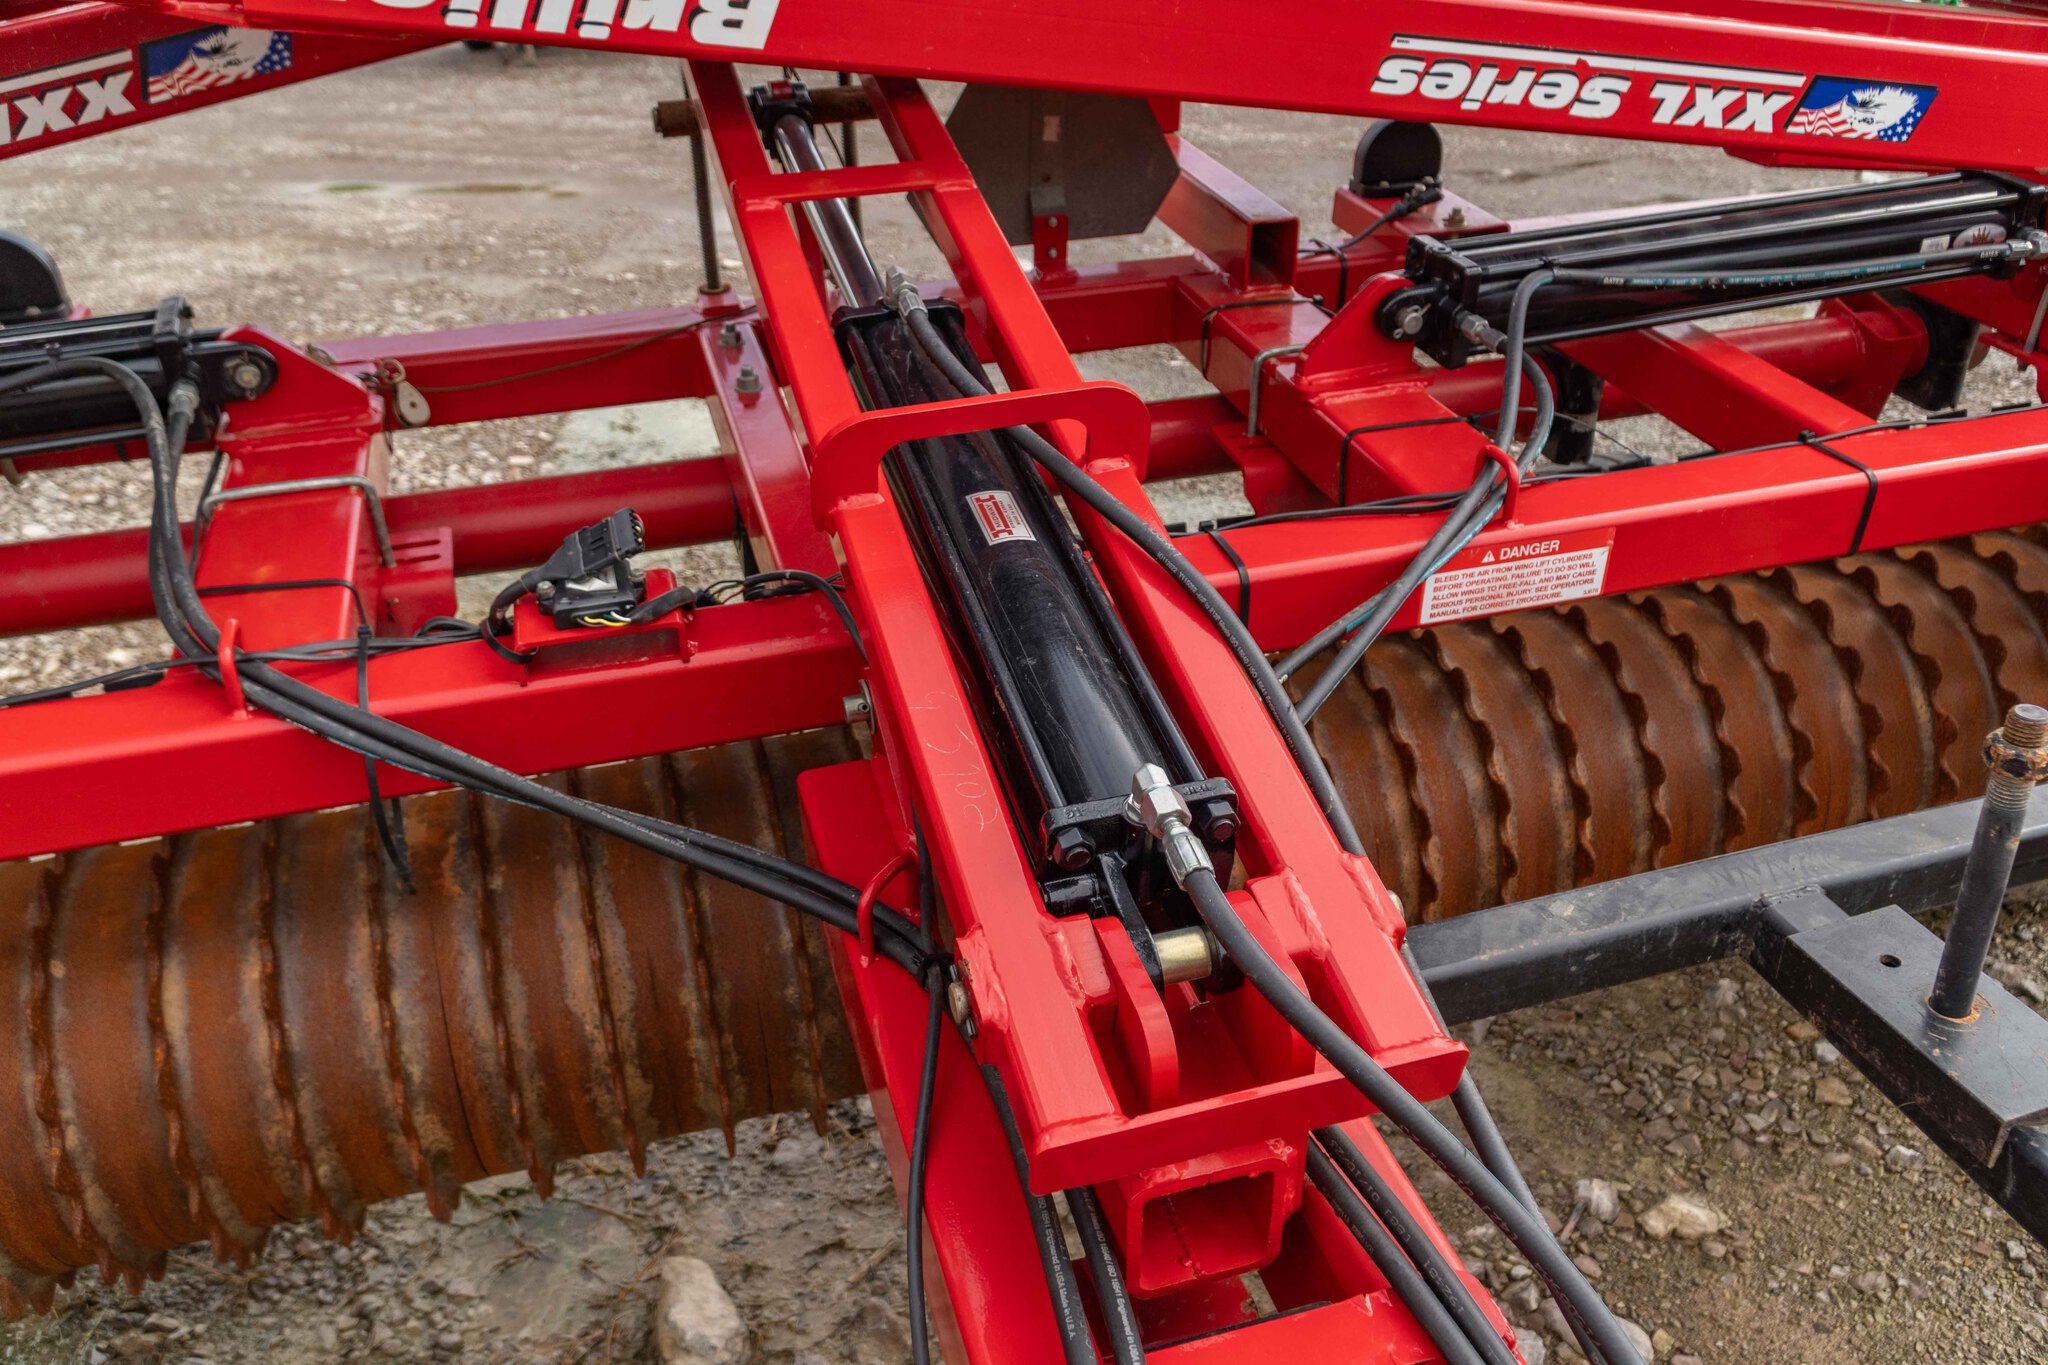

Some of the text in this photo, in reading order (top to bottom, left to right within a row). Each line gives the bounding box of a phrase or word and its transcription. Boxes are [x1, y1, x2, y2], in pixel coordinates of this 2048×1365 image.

[1370, 54, 1795, 133] XXL Series
[987, 504, 1001, 528] MIDWAY
[1500, 540, 1560, 560] DANGER
[1433, 581, 1463, 592] BEFORE
[1511, 569, 1541, 580] FAILURE
[1544, 567, 1553, 575] TO
[1555, 565, 1565, 573] DO
[1567, 563, 1577, 571] SO
[1579, 560, 1596, 569] WILL
[1435, 553, 1593, 584] BLEED THE AIR FROM WING LIFT CYLINDERS
[1431, 598, 1462, 610] SERIOUS
[1465, 591, 1504, 604] PERSONAL
[1535, 584, 1549, 593] SEE
[1551, 577, 1594, 590] OPERATORS
[1432, 569, 1596, 601] ALLOW WINGS TO FREE-FALL AND MAY CAUSE
[1429, 607, 1460, 618] MANUAL
[1462, 604, 1477, 613] FOR
[1479, 598, 1514, 610] CORRECT
[1228, 634, 1239, 647] ISO
[1248, 665, 1258, 678] ISO
[1043, 1227, 1060, 1264] Engineered
[1095, 1229, 1105, 1242] ISO
[1055, 1271, 1066, 1288] USA
[1105, 1263, 1117, 1277] ISO
[1058, 1287, 1069, 1308] Made
[1110, 1277, 1123, 1297] 15541
[1064, 1315, 1076, 1340] U.S.A.
[1114, 1297, 1133, 1335] Engineered
[1127, 1343, 1139, 1361] USA
